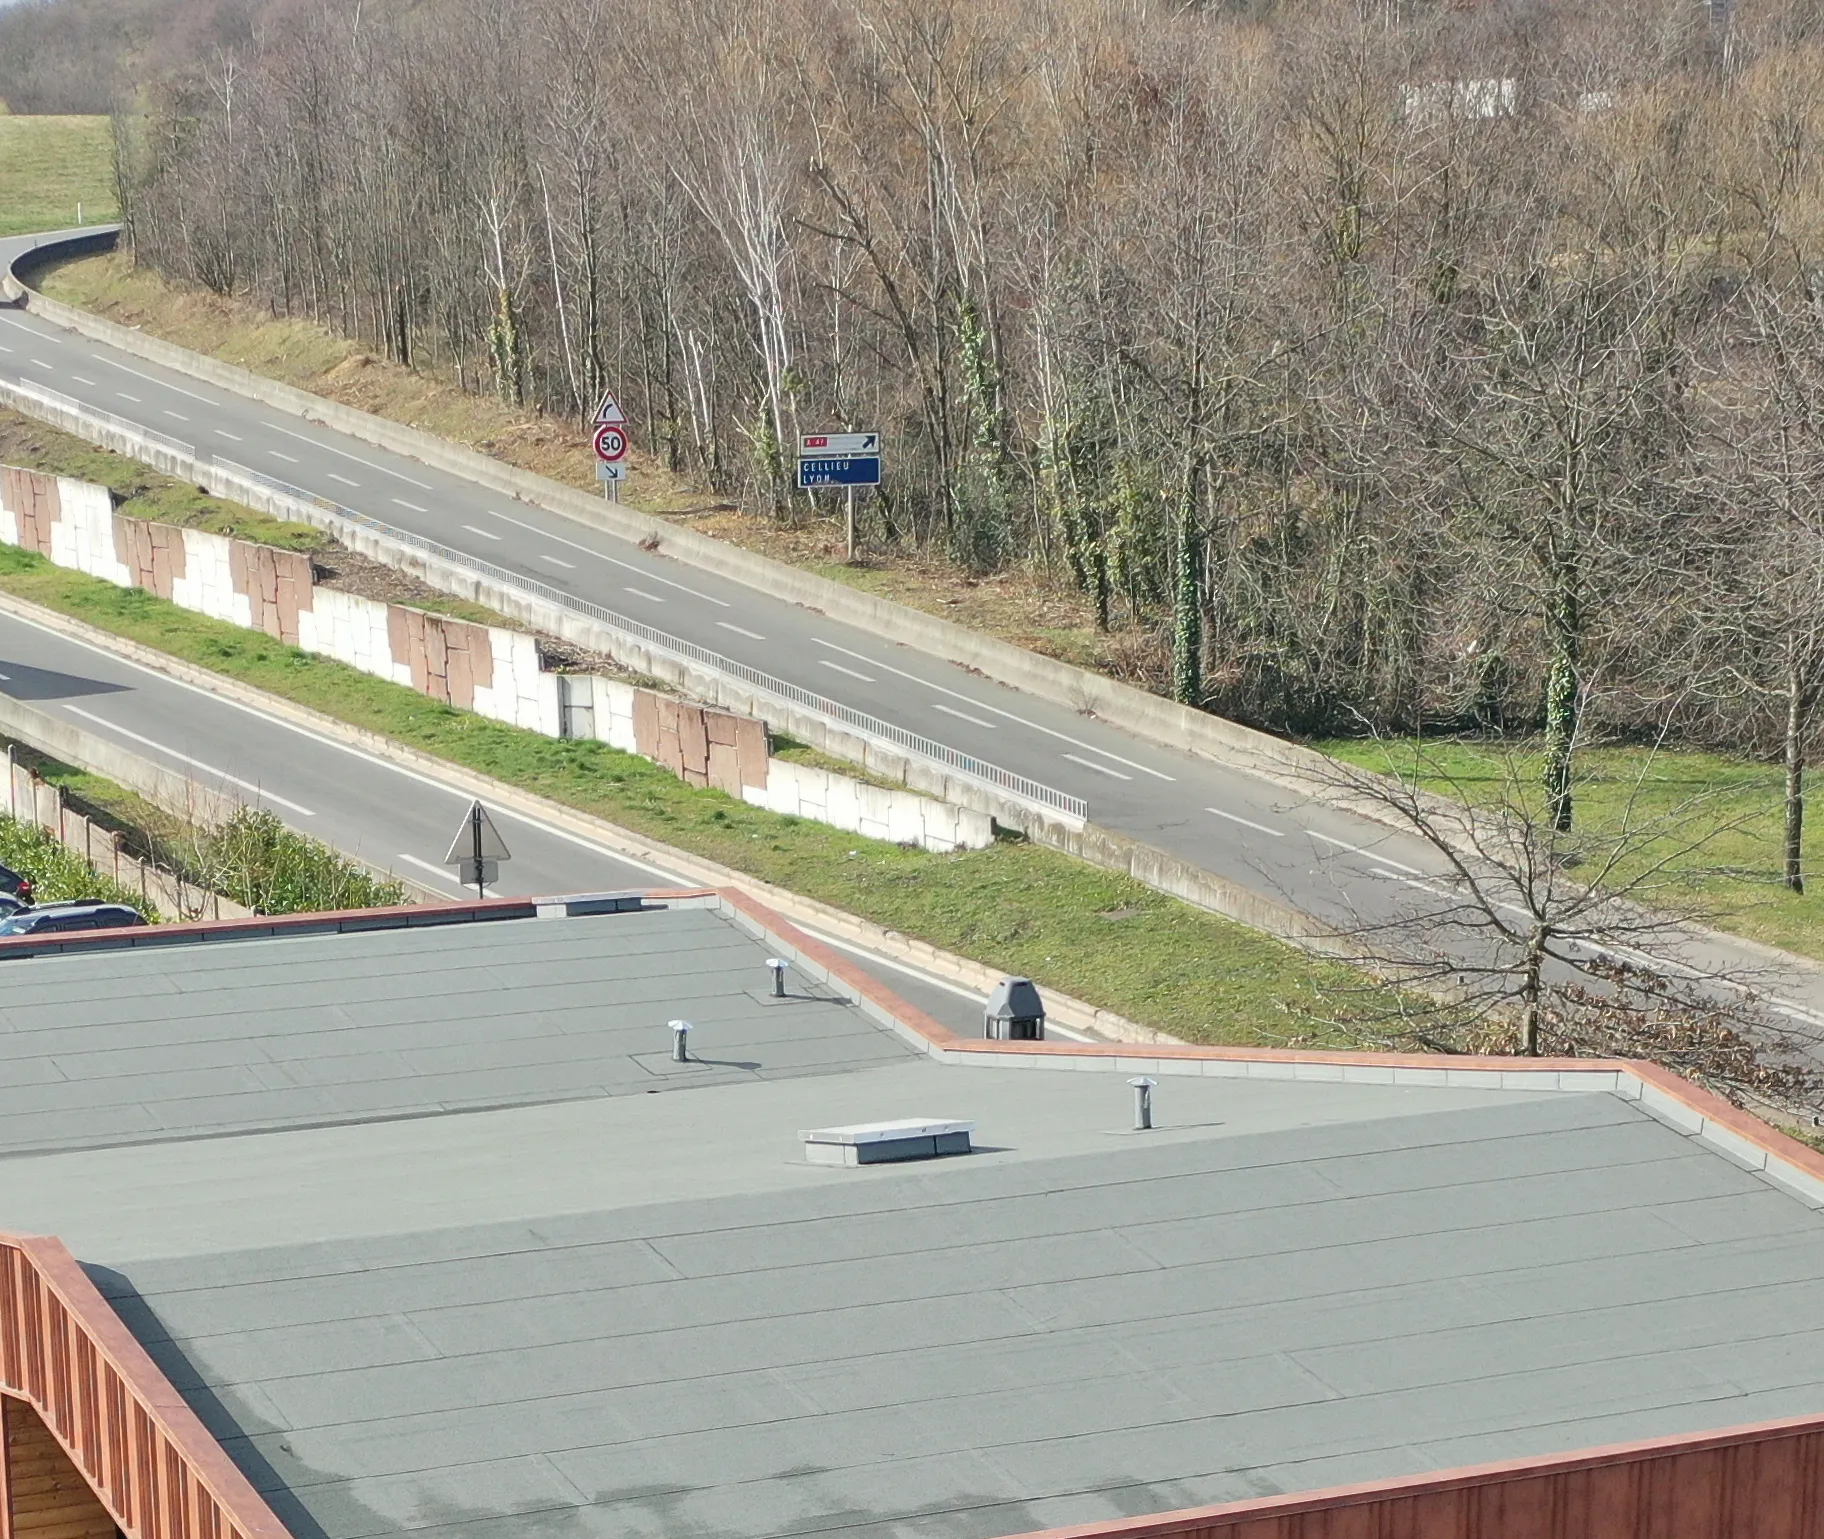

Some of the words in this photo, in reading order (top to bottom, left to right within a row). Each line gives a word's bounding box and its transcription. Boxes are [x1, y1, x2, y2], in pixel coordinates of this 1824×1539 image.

[601, 436, 621, 452] 50
[803, 462, 849, 472] CELLIEU
[803, 474, 831, 484] LYON
